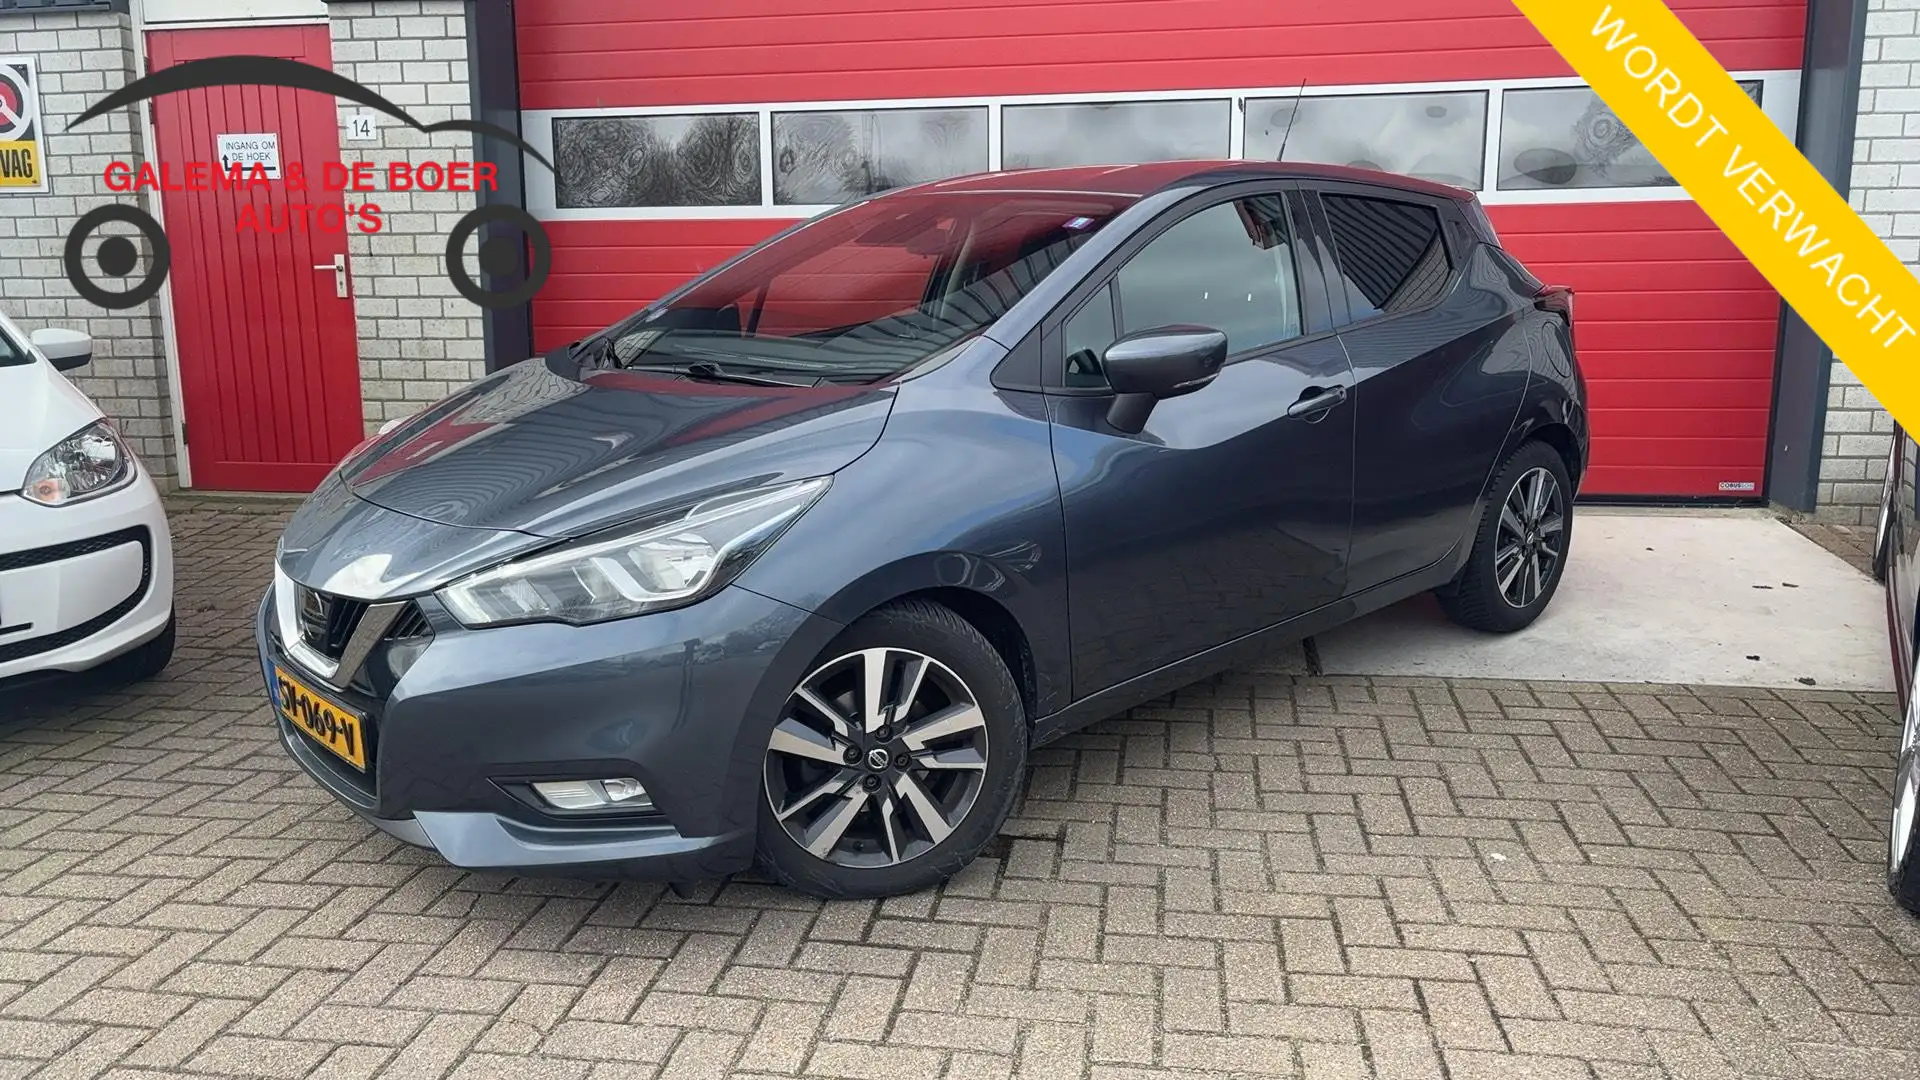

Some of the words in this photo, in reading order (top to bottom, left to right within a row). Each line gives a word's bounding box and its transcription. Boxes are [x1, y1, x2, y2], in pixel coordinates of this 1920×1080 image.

[353, 119, 370, 137] 14
[225, 142, 259, 150] INGANG
[261, 141, 276, 149] OM
[232, 152, 244, 161] DE
[247, 152, 271, 161] HOEK
